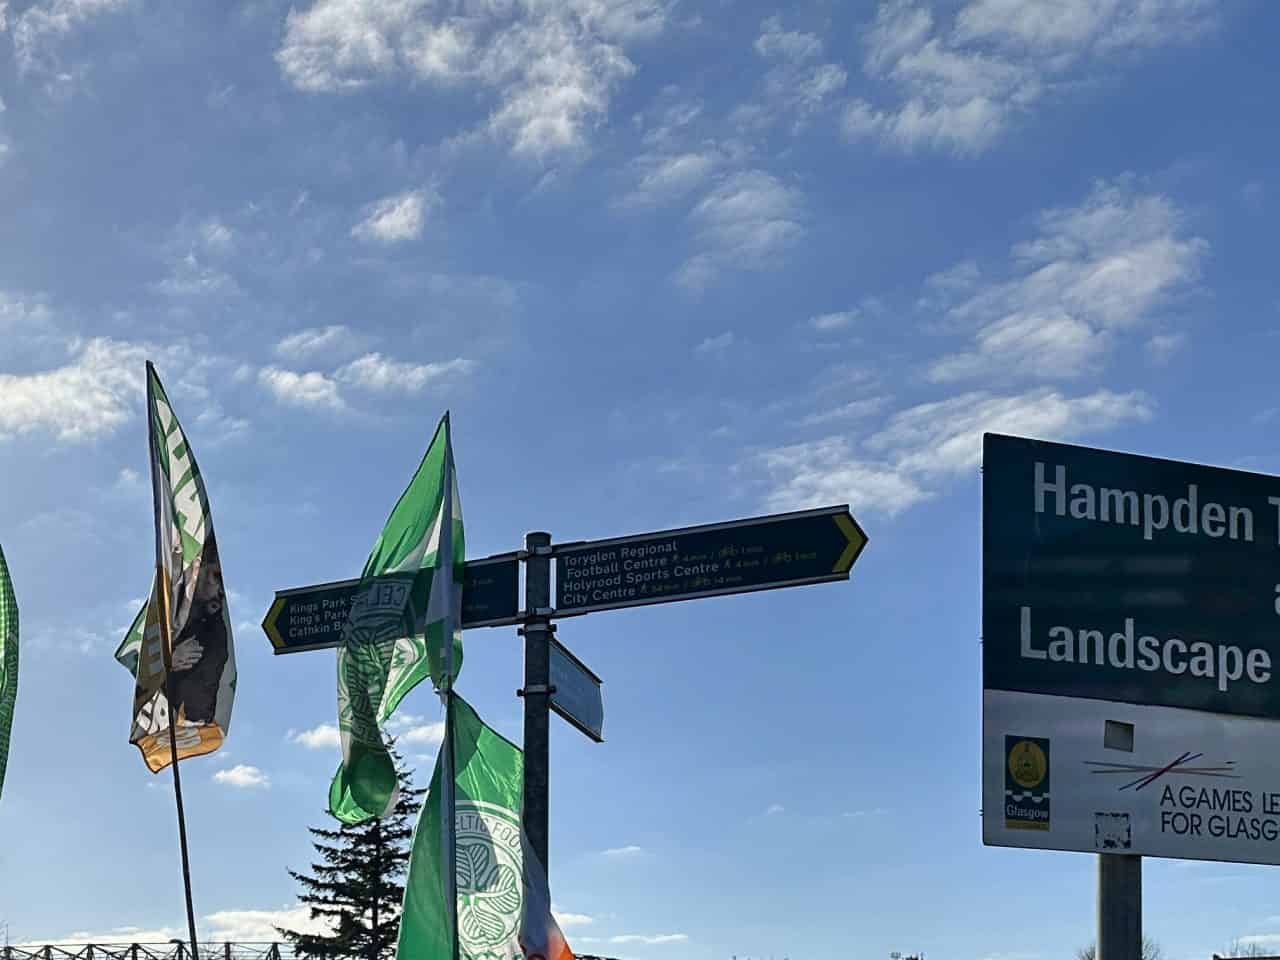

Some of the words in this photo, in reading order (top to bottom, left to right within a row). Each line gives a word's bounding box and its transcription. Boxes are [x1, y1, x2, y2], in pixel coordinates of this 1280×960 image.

[1033, 461, 1255, 542] Hampden
[563, 549, 617, 569] Toryglen
[620, 540, 679, 560] Regional
[563, 575, 621, 593] Holyrood
[625, 567, 670, 585] Sports
[673, 562, 720, 577] Centre
[567, 562, 620, 579] Football
[623, 556, 668, 571] Centre
[321, 598, 346, 610] Park
[562, 590, 589, 607] City
[592, 586, 637, 602] Centre
[323, 609, 349, 621] Park
[289, 623, 331, 638] Cathkin
[1020, 605, 1273, 692] Landscape
[1160, 784, 1176, 808] A
[1177, 785, 1254, 814] GAMES
[1006, 803, 1050, 821] Glasgow
[1160, 811, 1202, 835] FOR
[492, 822, 522, 850] FOO
